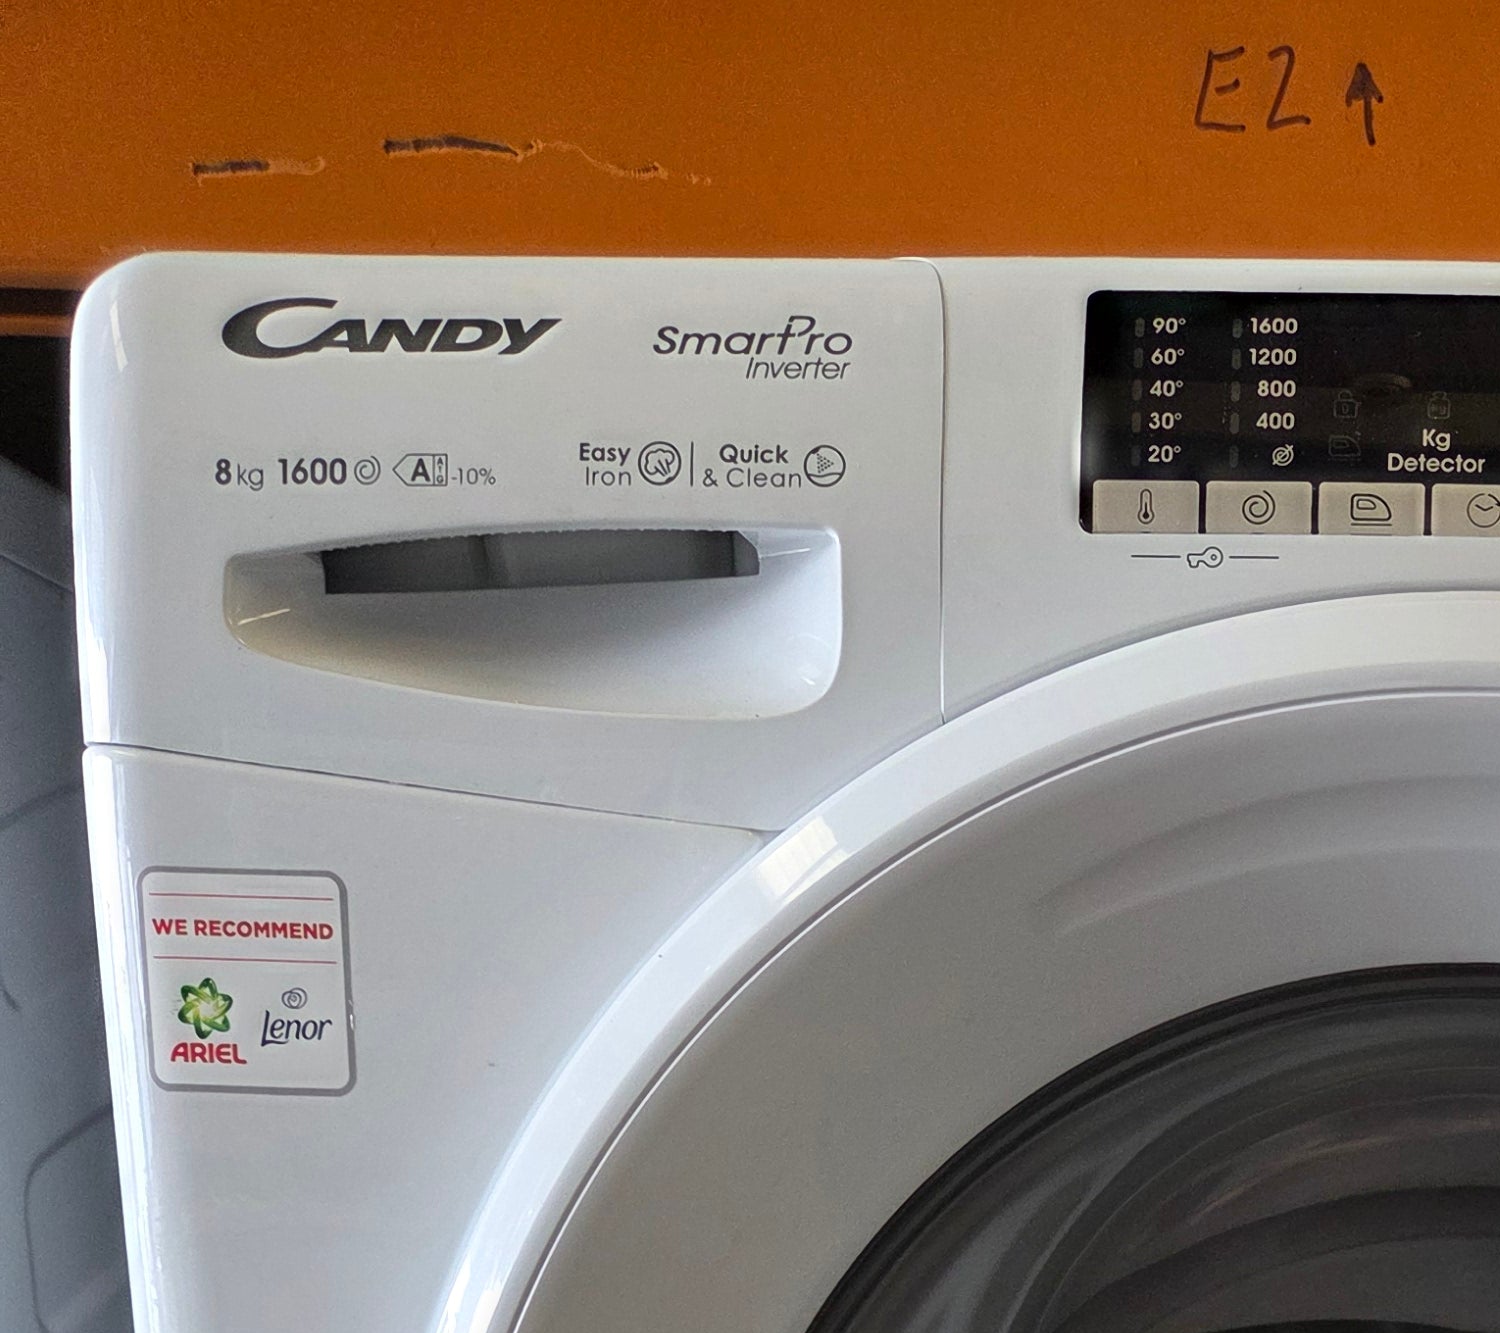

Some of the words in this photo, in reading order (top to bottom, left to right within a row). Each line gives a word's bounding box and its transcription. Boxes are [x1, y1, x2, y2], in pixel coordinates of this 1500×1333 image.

[1194, 45, 1311, 133] E2
[221, 297, 562, 359] CANDY
[1152, 318, 1186, 335] 90°
[1250, 317, 1298, 335] 1600
[1151, 348, 1185, 366] 60°
[1249, 348, 1297, 366] 1200
[745, 357, 851, 381] Inverter
[1149, 380, 1184, 398] 40°
[1257, 380, 1296, 397] 800
[1148, 412, 1182, 429] 30°
[1256, 412, 1295, 430] 400
[1422, 428, 1451, 451] Kg
[579, 442, 631, 466] Easy
[719, 444, 789, 466] Quick
[1147, 445, 1182, 463] 20°
[1387, 452, 1486, 473] Detector
[215, 458, 231, 485] 8
[237, 459, 264, 491] kg
[278, 458, 347, 485] 1600
[410, 457, 431, 482] A
[451, 467, 496, 486] -10%
[584, 466, 632, 487] Iron
[703, 467, 717, 488] &
[726, 466, 802, 489] Clean
[152, 918, 188, 936] WE
[194, 919, 334, 940] RECOMMEND
[261, 1010, 333, 1047] Lenor
[170, 1042, 247, 1065] ARIEL
